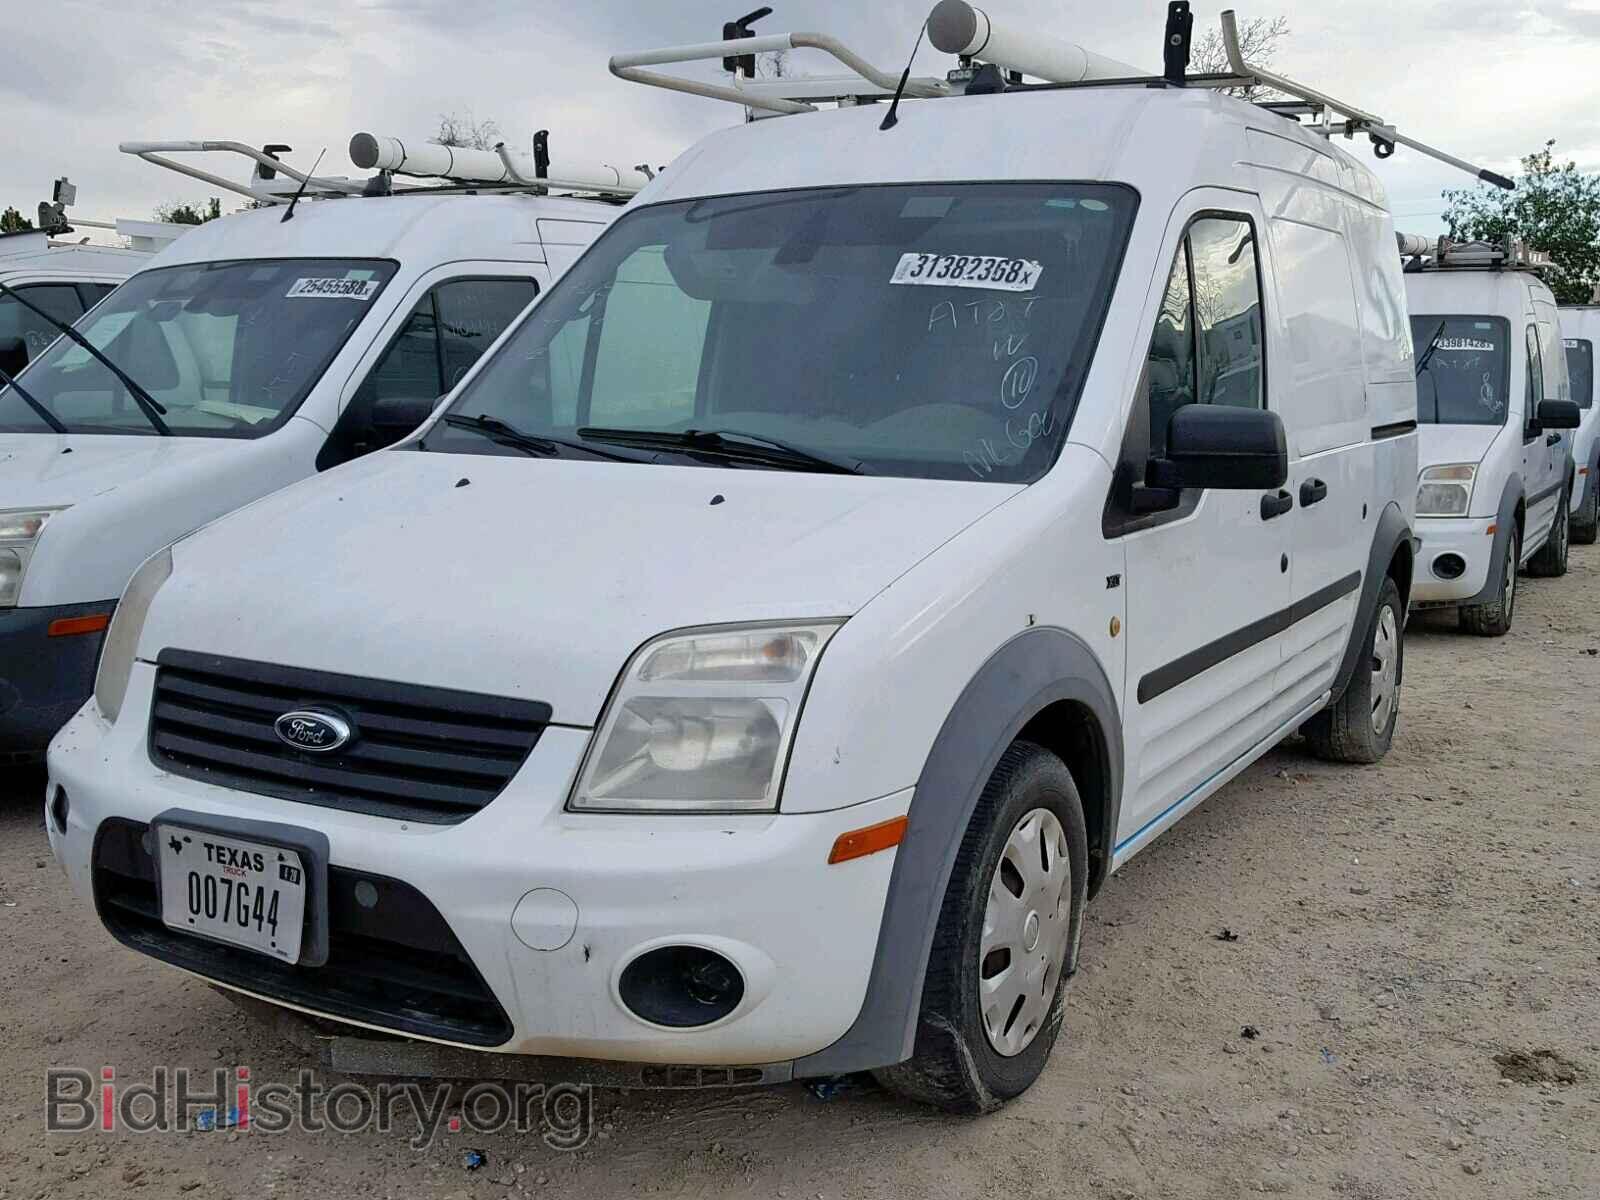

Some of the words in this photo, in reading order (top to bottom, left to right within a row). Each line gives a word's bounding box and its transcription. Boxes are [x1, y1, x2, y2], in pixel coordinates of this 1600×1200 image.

[288, 719, 325, 743] Ford
[204, 843, 264, 872] TEXAS
[223, 866, 246, 878] TRUCK
[188, 871, 280, 937] 007G44
